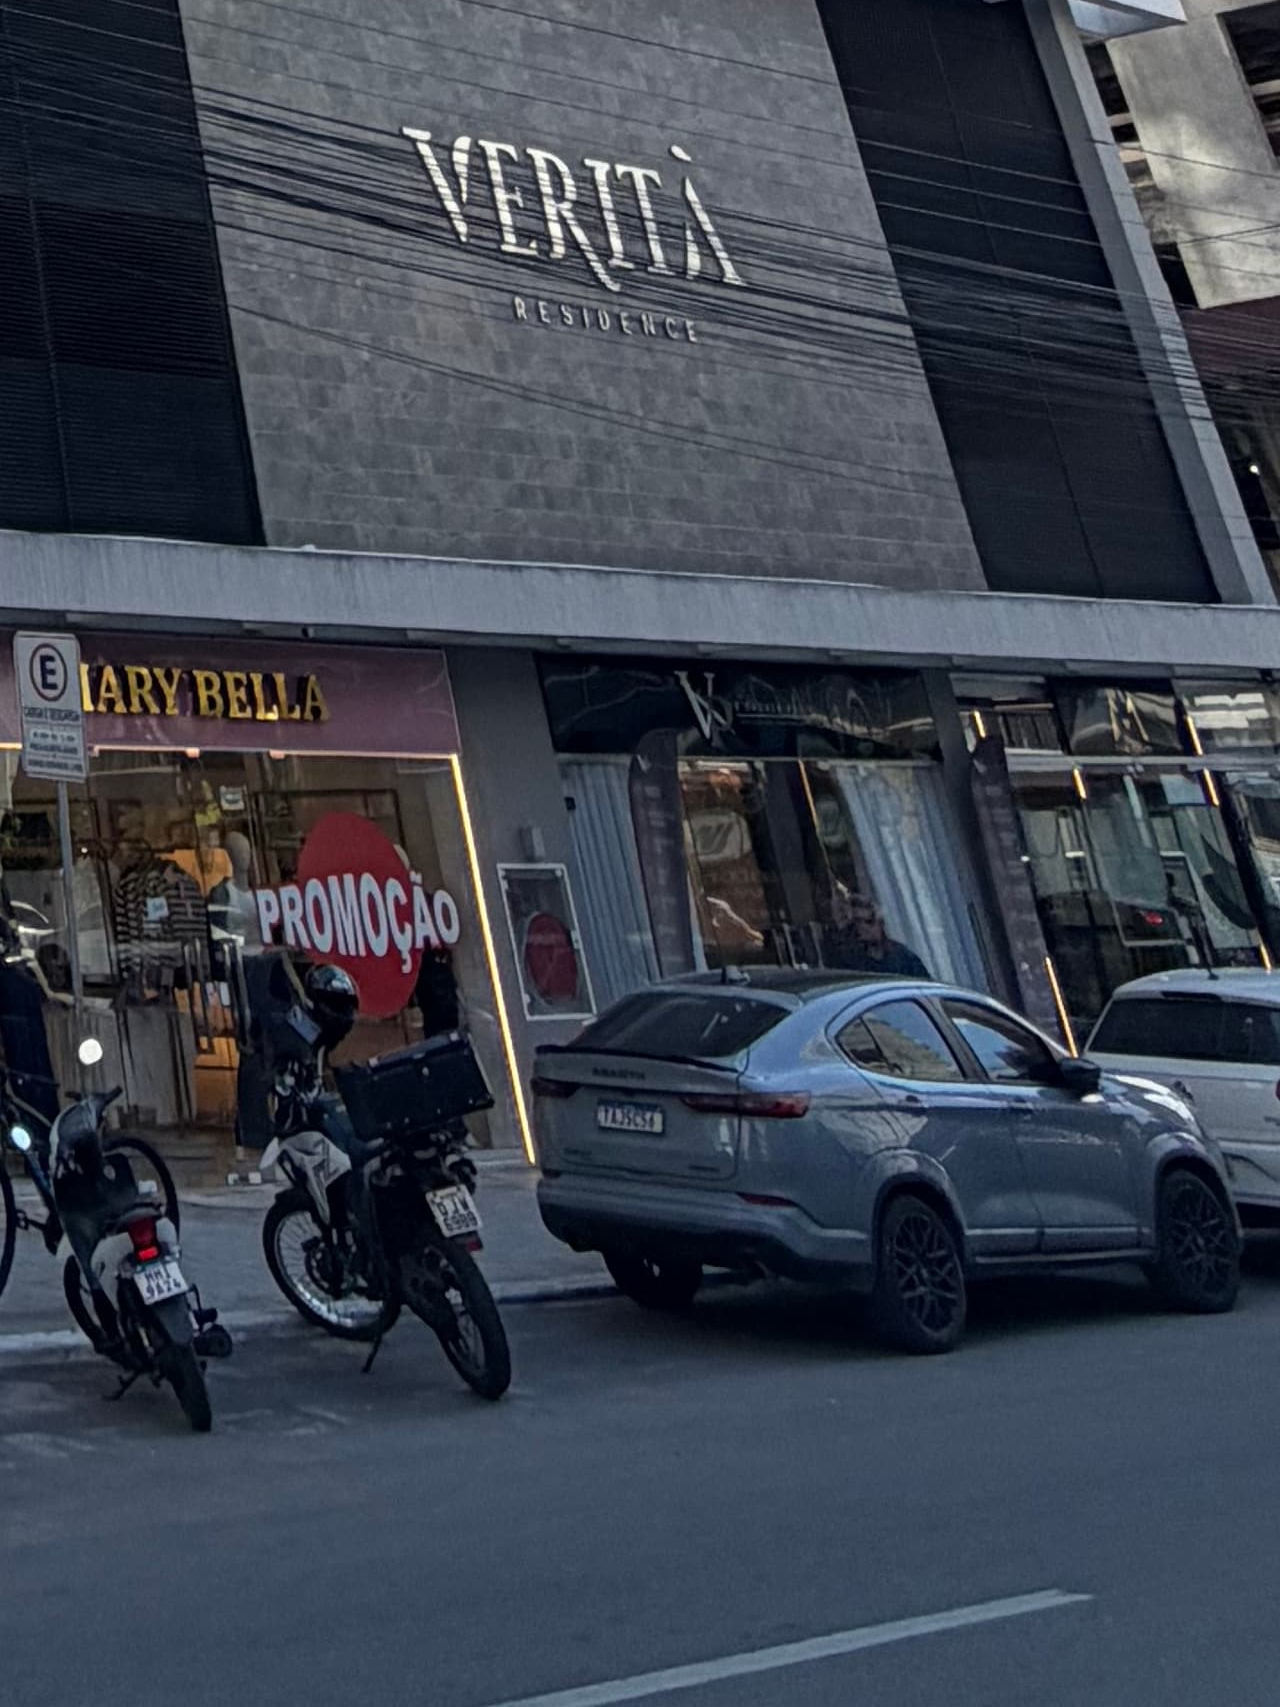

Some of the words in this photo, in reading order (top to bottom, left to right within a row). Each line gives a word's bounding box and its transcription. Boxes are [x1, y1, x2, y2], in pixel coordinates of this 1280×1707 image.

[401, 126, 746, 292] VERITÀ
[513, 296, 698, 343] RESIDENCE
[39, 654, 59, 690] E
[192, 669, 331, 721] BELLA
[256, 871, 460, 973] PROMOÇÃO
